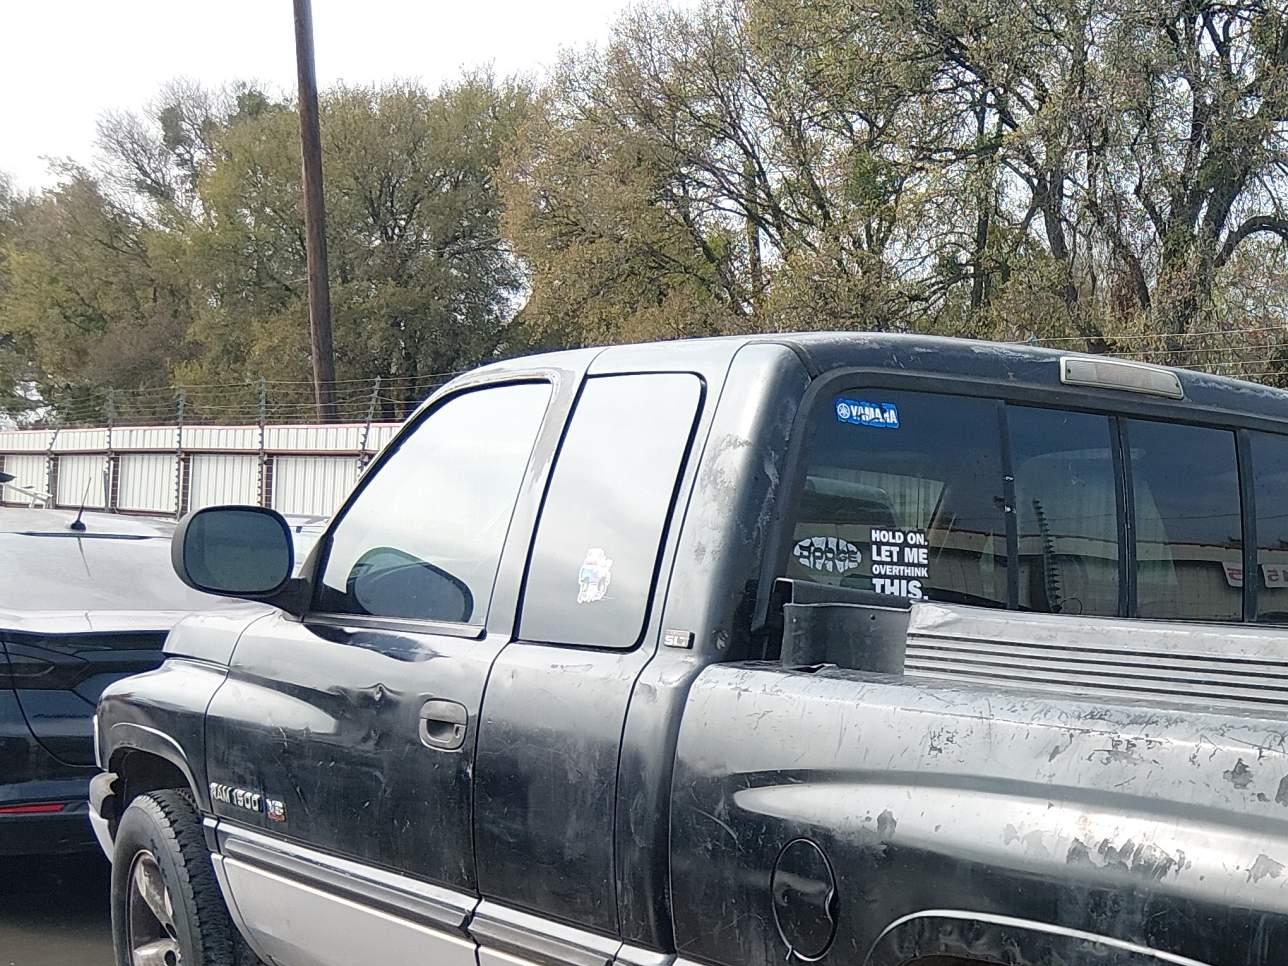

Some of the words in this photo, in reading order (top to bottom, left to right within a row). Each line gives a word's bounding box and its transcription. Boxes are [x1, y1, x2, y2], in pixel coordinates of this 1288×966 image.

[871, 529, 904, 543] HOLD
[907, 532, 928, 546] ON.
[871, 544, 900, 562] LET
[904, 547, 929, 564] ME
[872, 564, 929, 578] OVERTHINK
[872, 578, 929, 600] THIS.
[210, 782, 232, 804] RAM
[232, 788, 261, 811] 1500
